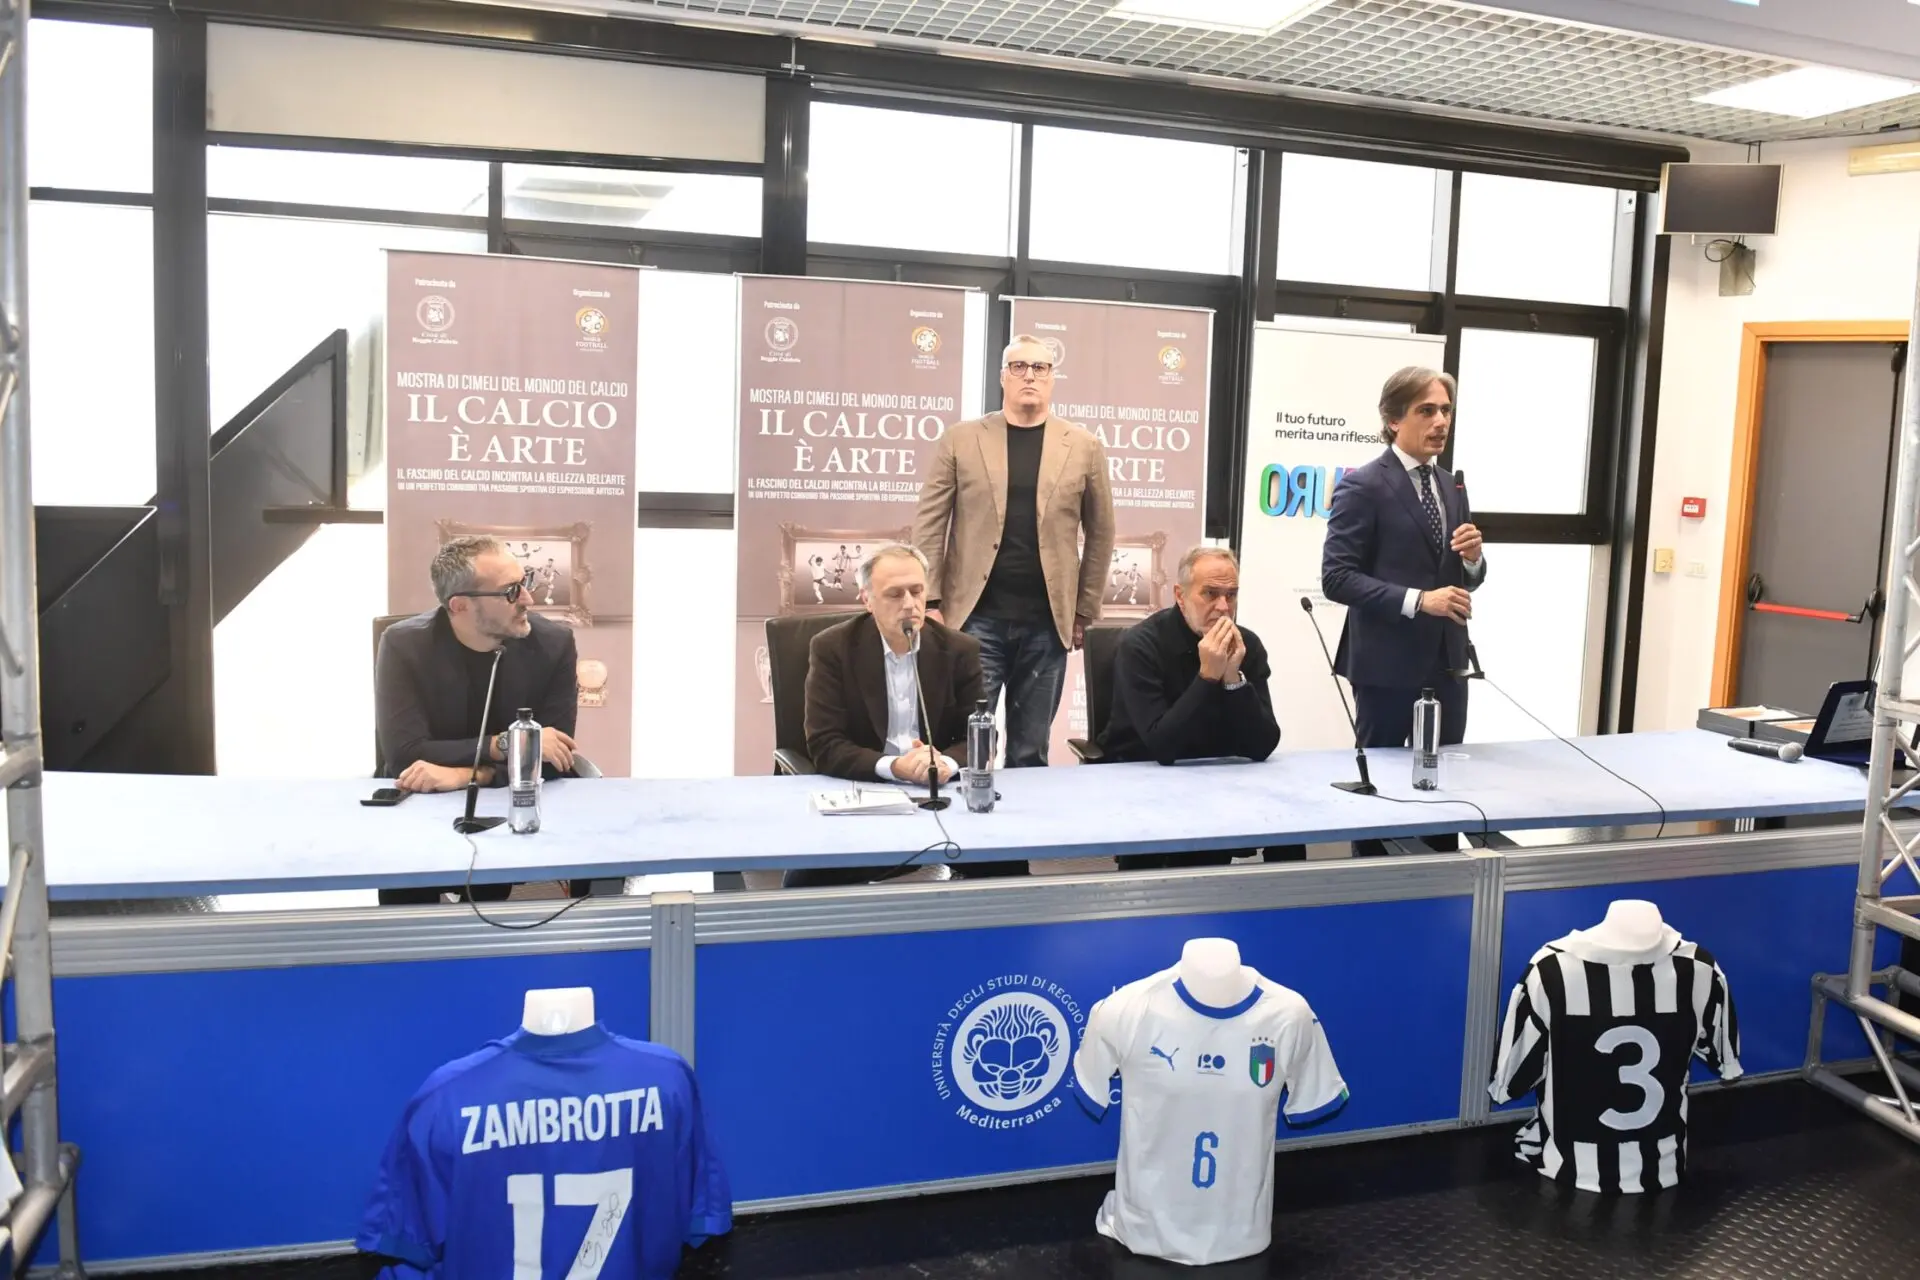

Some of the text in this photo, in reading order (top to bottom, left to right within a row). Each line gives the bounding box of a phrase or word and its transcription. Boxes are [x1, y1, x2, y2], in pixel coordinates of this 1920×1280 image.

[397, 371, 628, 397] MOSTRA DI CIMELI DEL MONDO DEL CALCIO
[750, 388, 954, 411] MOSTRA DI CIMELI DEL MONDO DEL CALCIO
[407, 393, 617, 430] IL CALCIO
[759, 408, 945, 442] IL CALCIO
[1059, 404, 1067, 417] DI
[1070, 404, 1098, 418] CIMELI
[1100, 405, 1116, 419] DEL
[1118, 407, 1150, 422] MONDO
[1152, 408, 1167, 422] DEL
[1169, 409, 1199, 424] CALCIO
[1276, 412, 1346, 426] Il tuo futuro
[448, 426, 587, 465] È ARTE
[1075, 422, 1190, 452] ALCIO
[1275, 428, 1314, 440] merita
[1316, 431, 1339, 442] una
[793, 438, 916, 475] È ARTE
[1106, 456, 1165, 482] RTE
[397, 468, 405, 479] IL
[407, 468, 442, 480] FASCINO
[444, 469, 460, 480] DEL
[462, 469, 490, 481] CALCIO
[492, 470, 532, 482] INCONTRA
[535, 472, 545, 483] LA
[547, 472, 585, 484] BELLEZZA
[748, 478, 754, 488] IL
[756, 478, 788, 489] FASCINO
[789, 479, 802, 489] DEL
[804, 479, 830, 489] CALCIO
[831, 480, 867, 491] INCONTRA
[869, 481, 878, 491] LA
[880, 481, 913, 492] BELLEZZA
[932, 974, 1084, 1100] UNIVERSITÀ DEGLI STUDI DI REGGIO
[1594, 1025, 1665, 1131] 3
[460, 1086, 664, 1155] ZAMBROTTA
[956, 1097, 1062, 1129] Mediterranea
[1191, 1131, 1219, 1188] 6
[507, 1167, 634, 1280] 17
